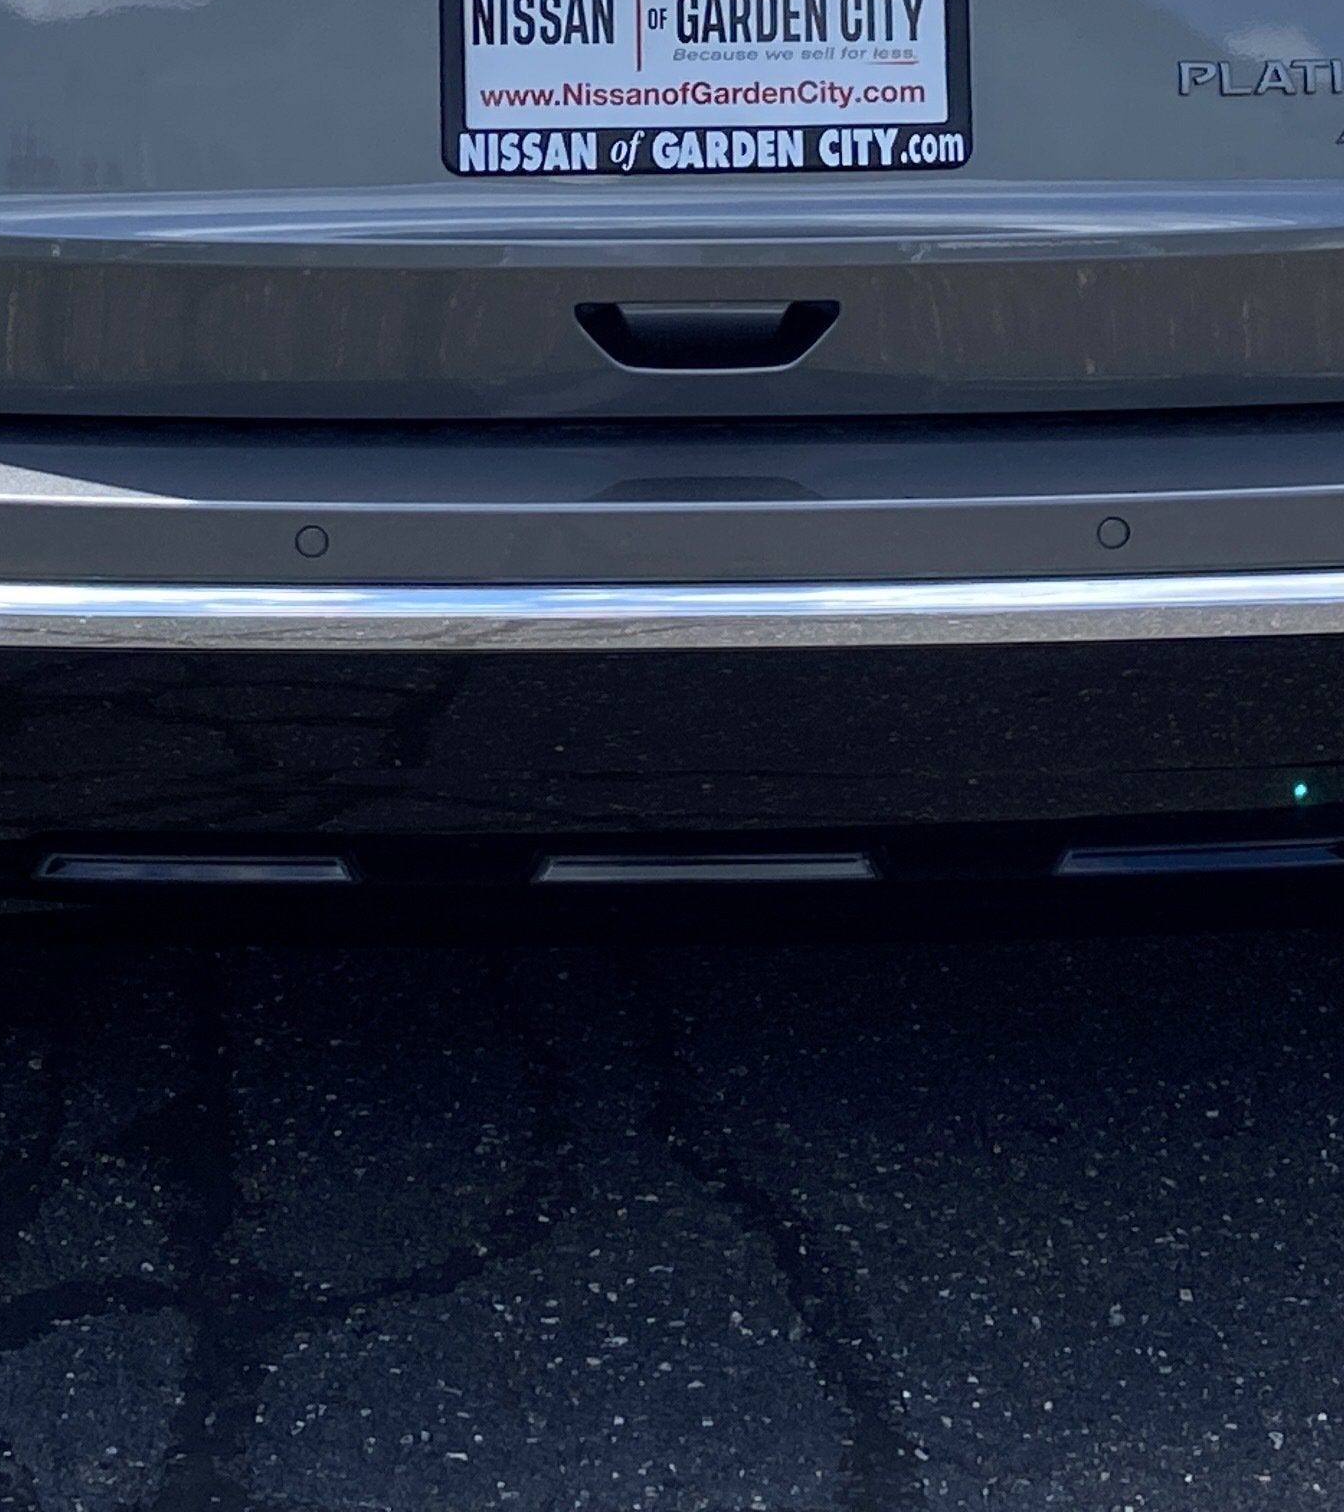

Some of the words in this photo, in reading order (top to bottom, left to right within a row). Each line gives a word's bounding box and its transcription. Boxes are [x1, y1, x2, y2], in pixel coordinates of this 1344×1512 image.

[648, 8, 668, 30] OF
[673, 48, 758, 62] Because
[765, 50, 794, 61] we
[801, 47, 835, 61] sell
[841, 46, 867, 60] for
[480, 80, 926, 109] www.NissanofGardenCity.com
[459, 131, 598, 172] NISSAN
[610, 130, 646, 172] of
[651, 129, 804, 171] GARDEN
[818, 127, 965, 167] CITY.com
